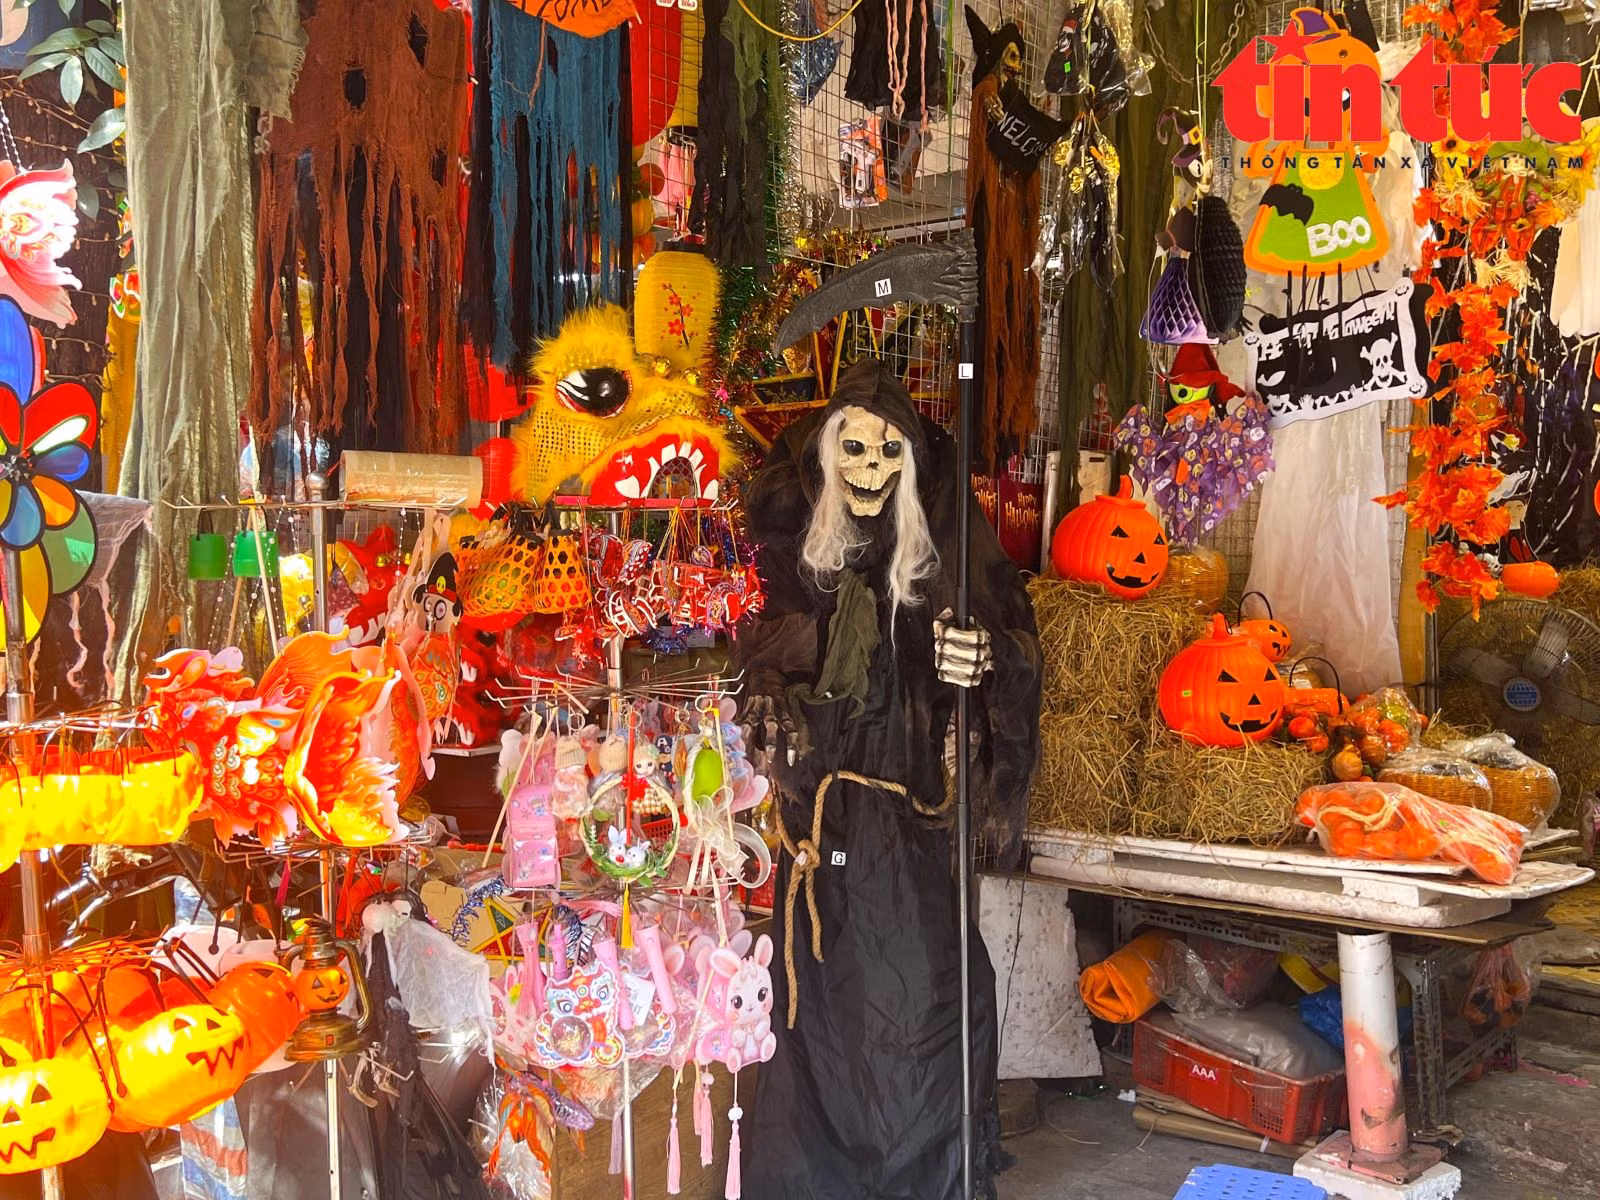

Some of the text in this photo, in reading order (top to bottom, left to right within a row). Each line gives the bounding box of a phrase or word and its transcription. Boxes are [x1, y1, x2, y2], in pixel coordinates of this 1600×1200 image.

[1306, 215, 1371, 258] BOO
[877, 280, 889, 294] M
[961, 365, 969, 378] L
[834, 852, 843, 864] G
[1191, 1064, 1216, 1081] AAA
